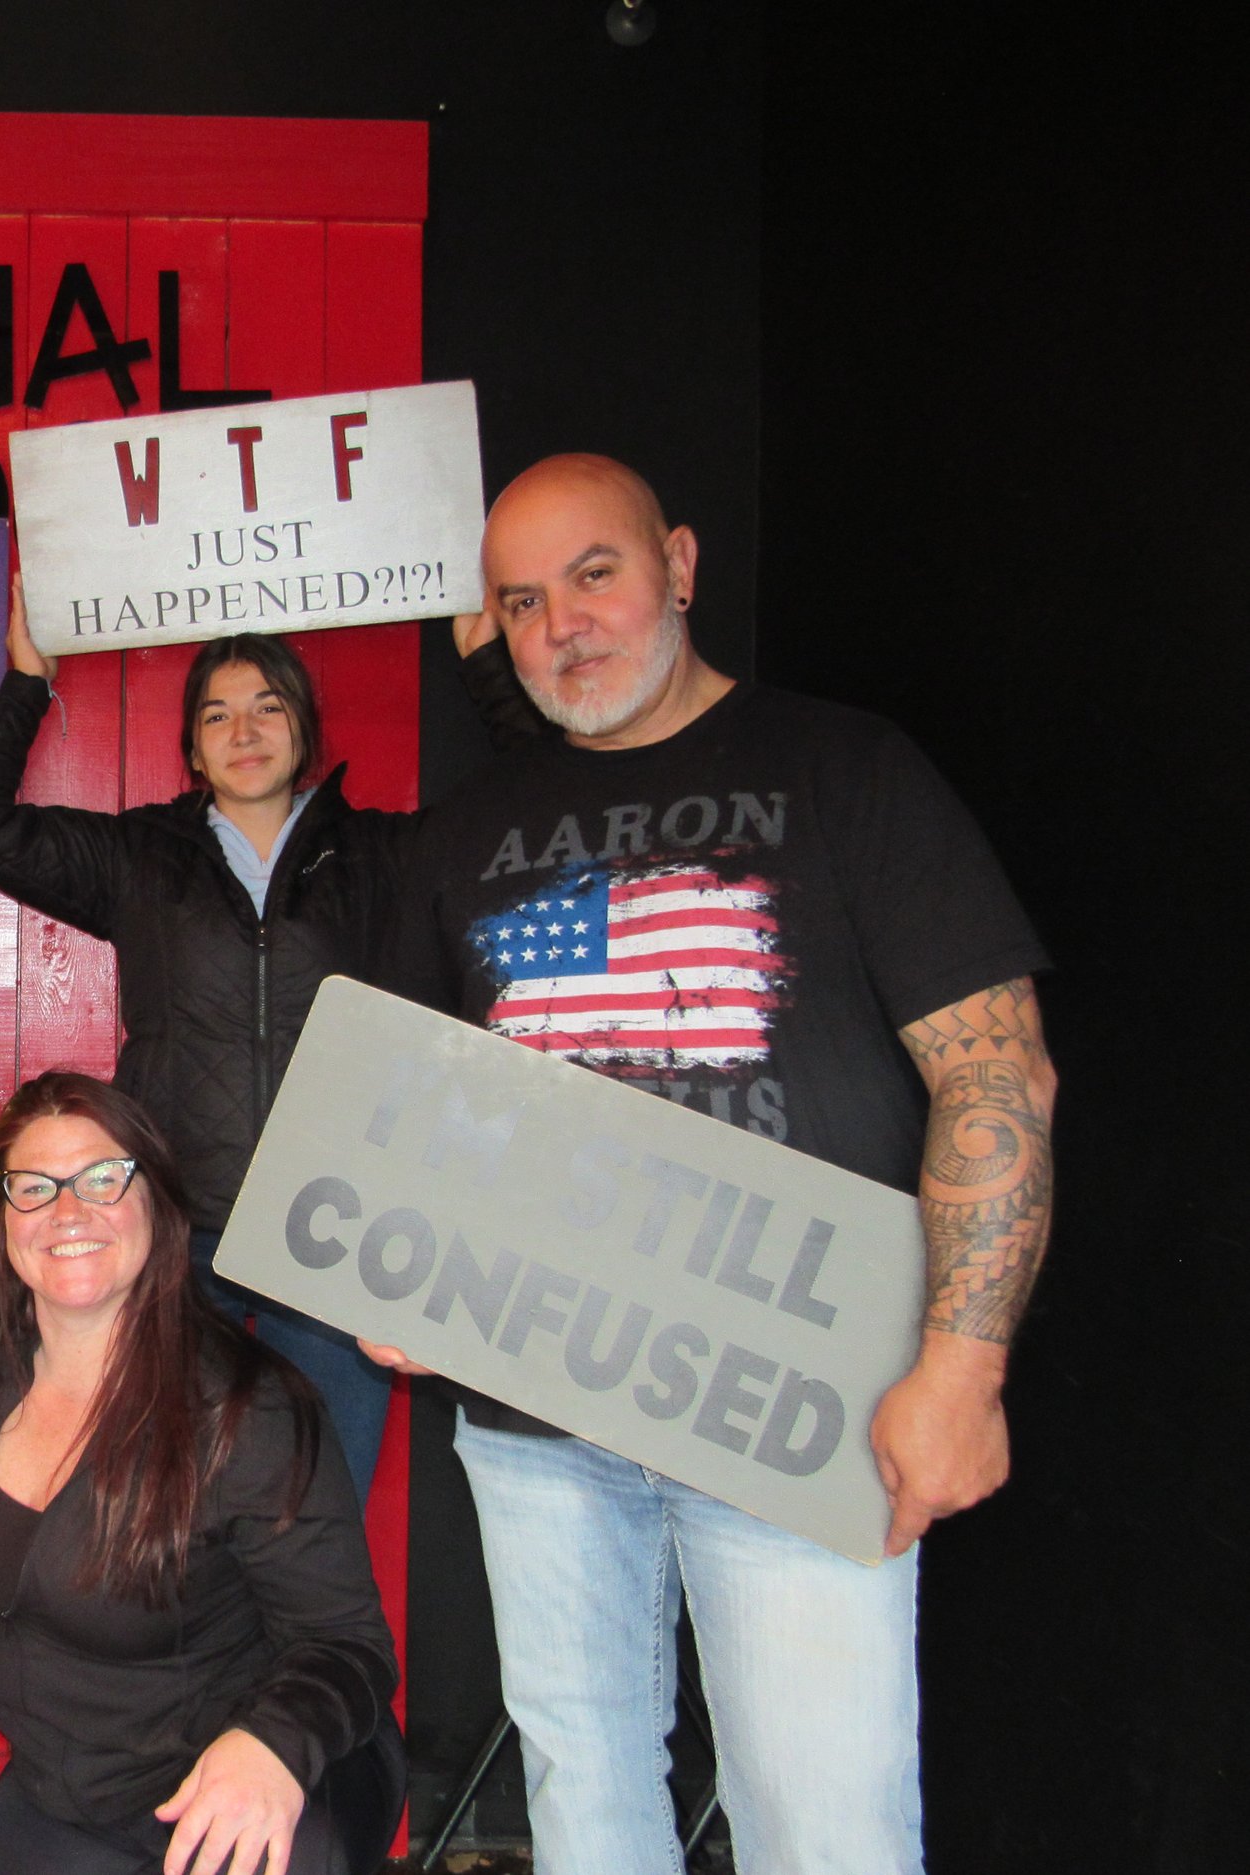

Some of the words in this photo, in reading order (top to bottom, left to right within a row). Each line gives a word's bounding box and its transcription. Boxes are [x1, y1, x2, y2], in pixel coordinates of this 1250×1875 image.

[187, 521, 313, 571] JUST
[70, 562, 447, 637] HAPPENED?!?!
[480, 792, 790, 882] AARON
[556, 1128, 839, 1330] STILL
[285, 1175, 846, 1477] CONFUSED
